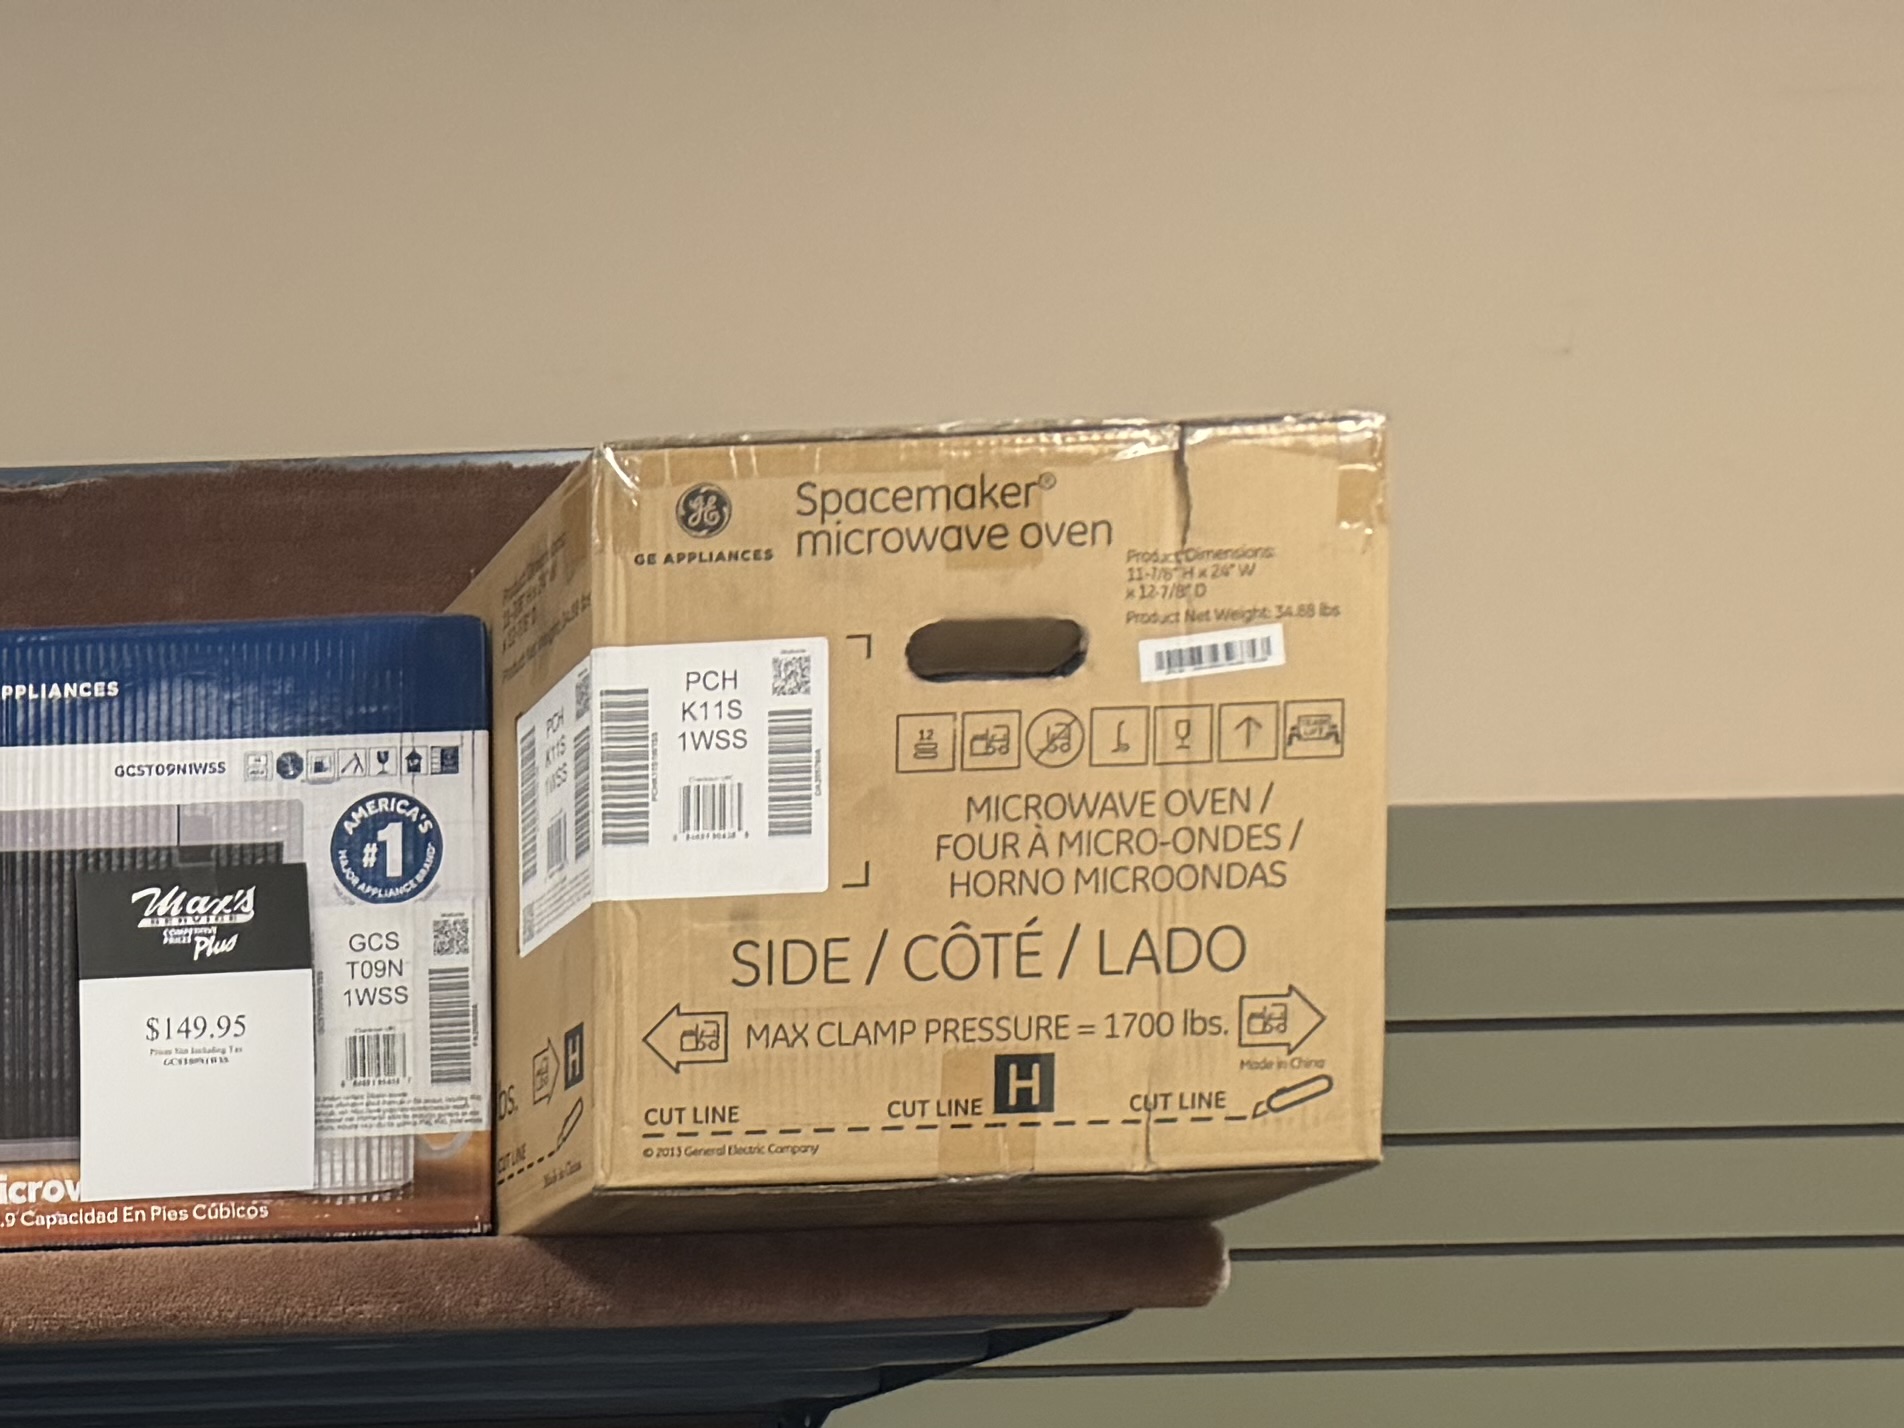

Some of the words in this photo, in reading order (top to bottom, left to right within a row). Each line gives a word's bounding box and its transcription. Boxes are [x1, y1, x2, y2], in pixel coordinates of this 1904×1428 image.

[795, 518, 1009, 557] microwave
[1021, 515, 1113, 550] oven
[684, 671, 738, 691] PCH
[681, 701, 743, 722] K11S
[677, 730, 749, 751] 1WSS
[966, 792, 1156, 823] MICROWAVE
[1165, 788, 1251, 818] OVEN
[936, 832, 1019, 861] FOUR
[1028, 822, 1051, 859] À
[1059, 825, 1283, 857] MICRO-ONDES
[950, 867, 1064, 898] HORNO
[1074, 860, 1288, 895] MICROONDAS
[349, 932, 400, 952] GCS
[731, 936, 851, 988] SIDE
[903, 917, 1044, 983] CÔTÉ
[1098, 924, 1247, 977] LADO
[346, 959, 404, 980] T09N
[344, 986, 408, 1007] 1WSS
[146, 1014, 247, 1042] $149.95
[746, 1021, 810, 1050] MAX
[818, 1019, 917, 1047] CLAMP
[925, 1014, 1070, 1044] PRESSURE
[1104, 1011, 1174, 1039] 1700
[1183, 1007, 1229, 1037] lbs.
[887, 1100, 930, 1120] CUT
[936, 1097, 983, 1118] LINE
